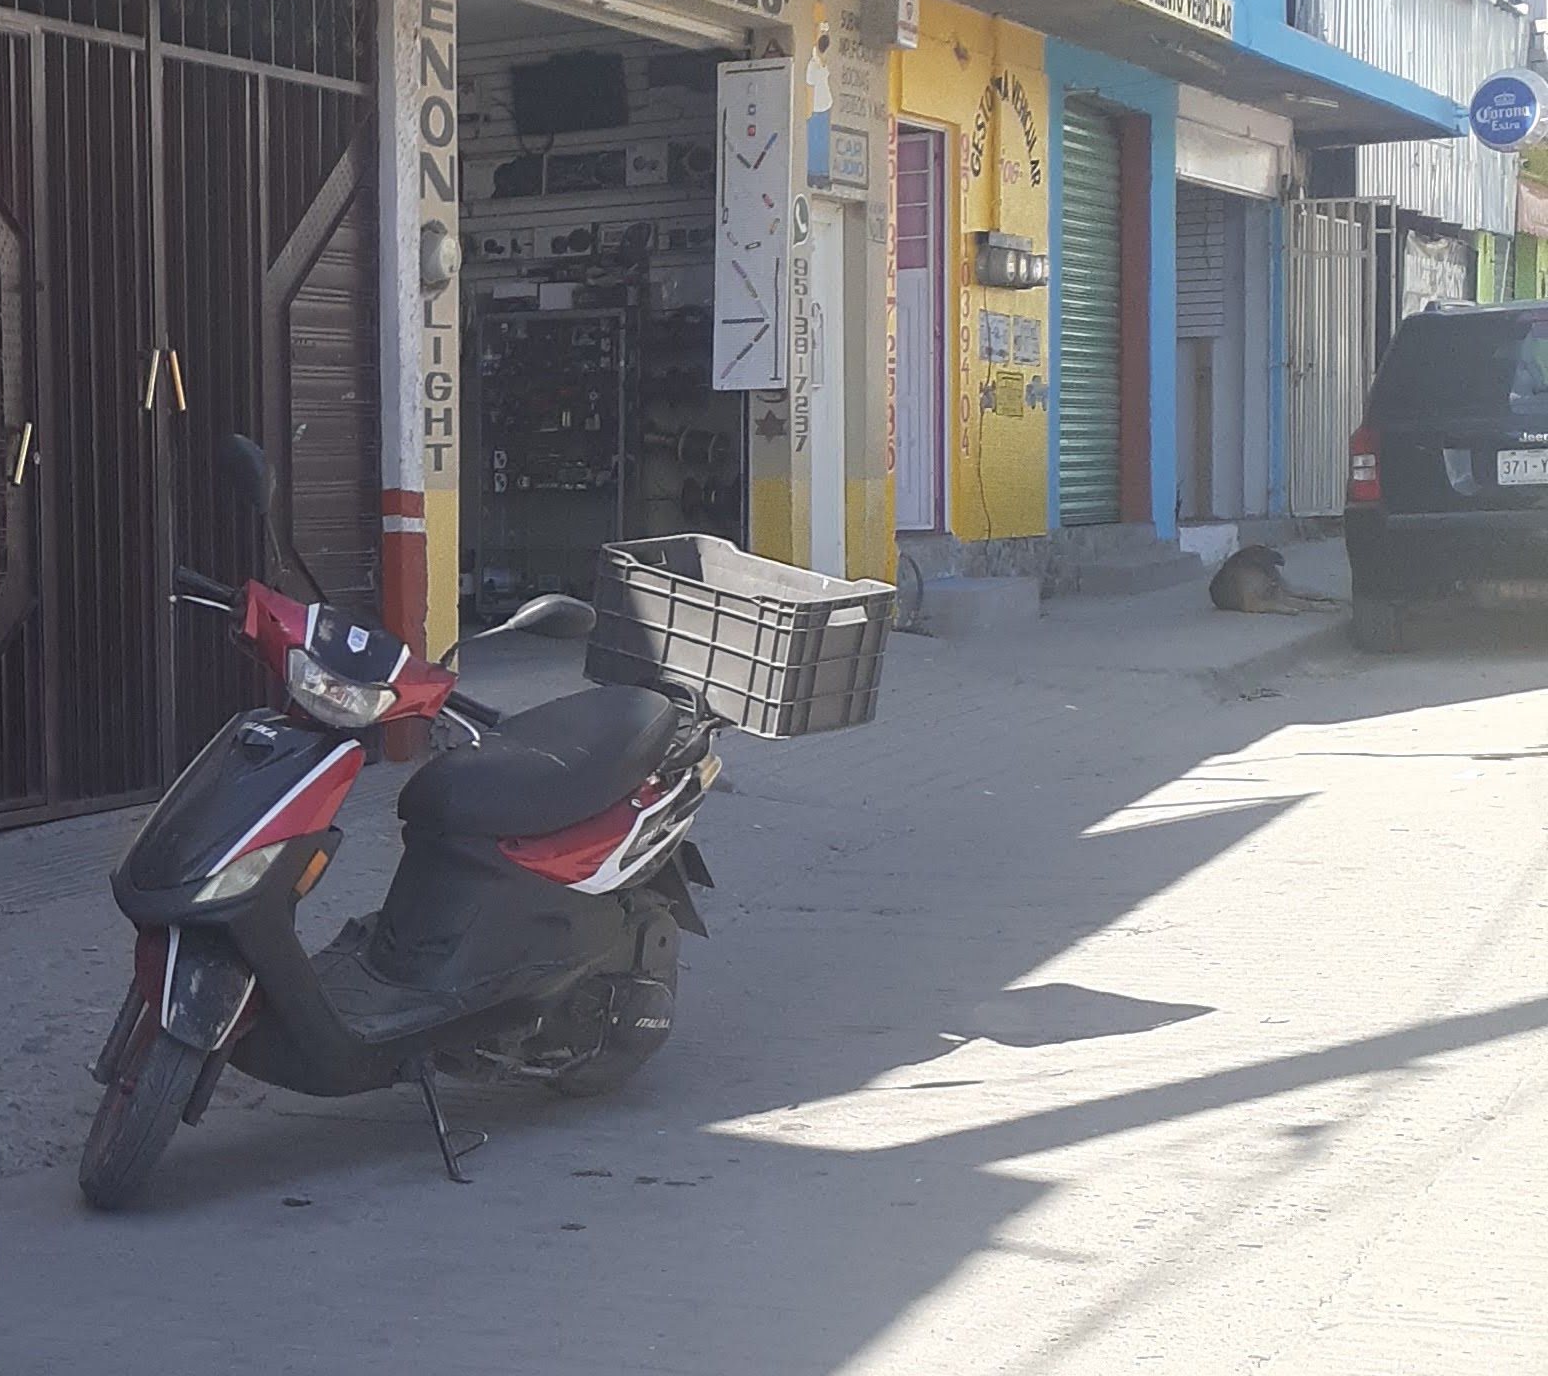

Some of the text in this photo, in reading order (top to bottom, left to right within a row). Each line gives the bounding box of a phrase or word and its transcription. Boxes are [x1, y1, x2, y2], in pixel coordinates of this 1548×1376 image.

[1475, 106, 1531, 123] Corona
[1492, 120, 1521, 131] Extra
[424, 300, 453, 472] LIGHT
